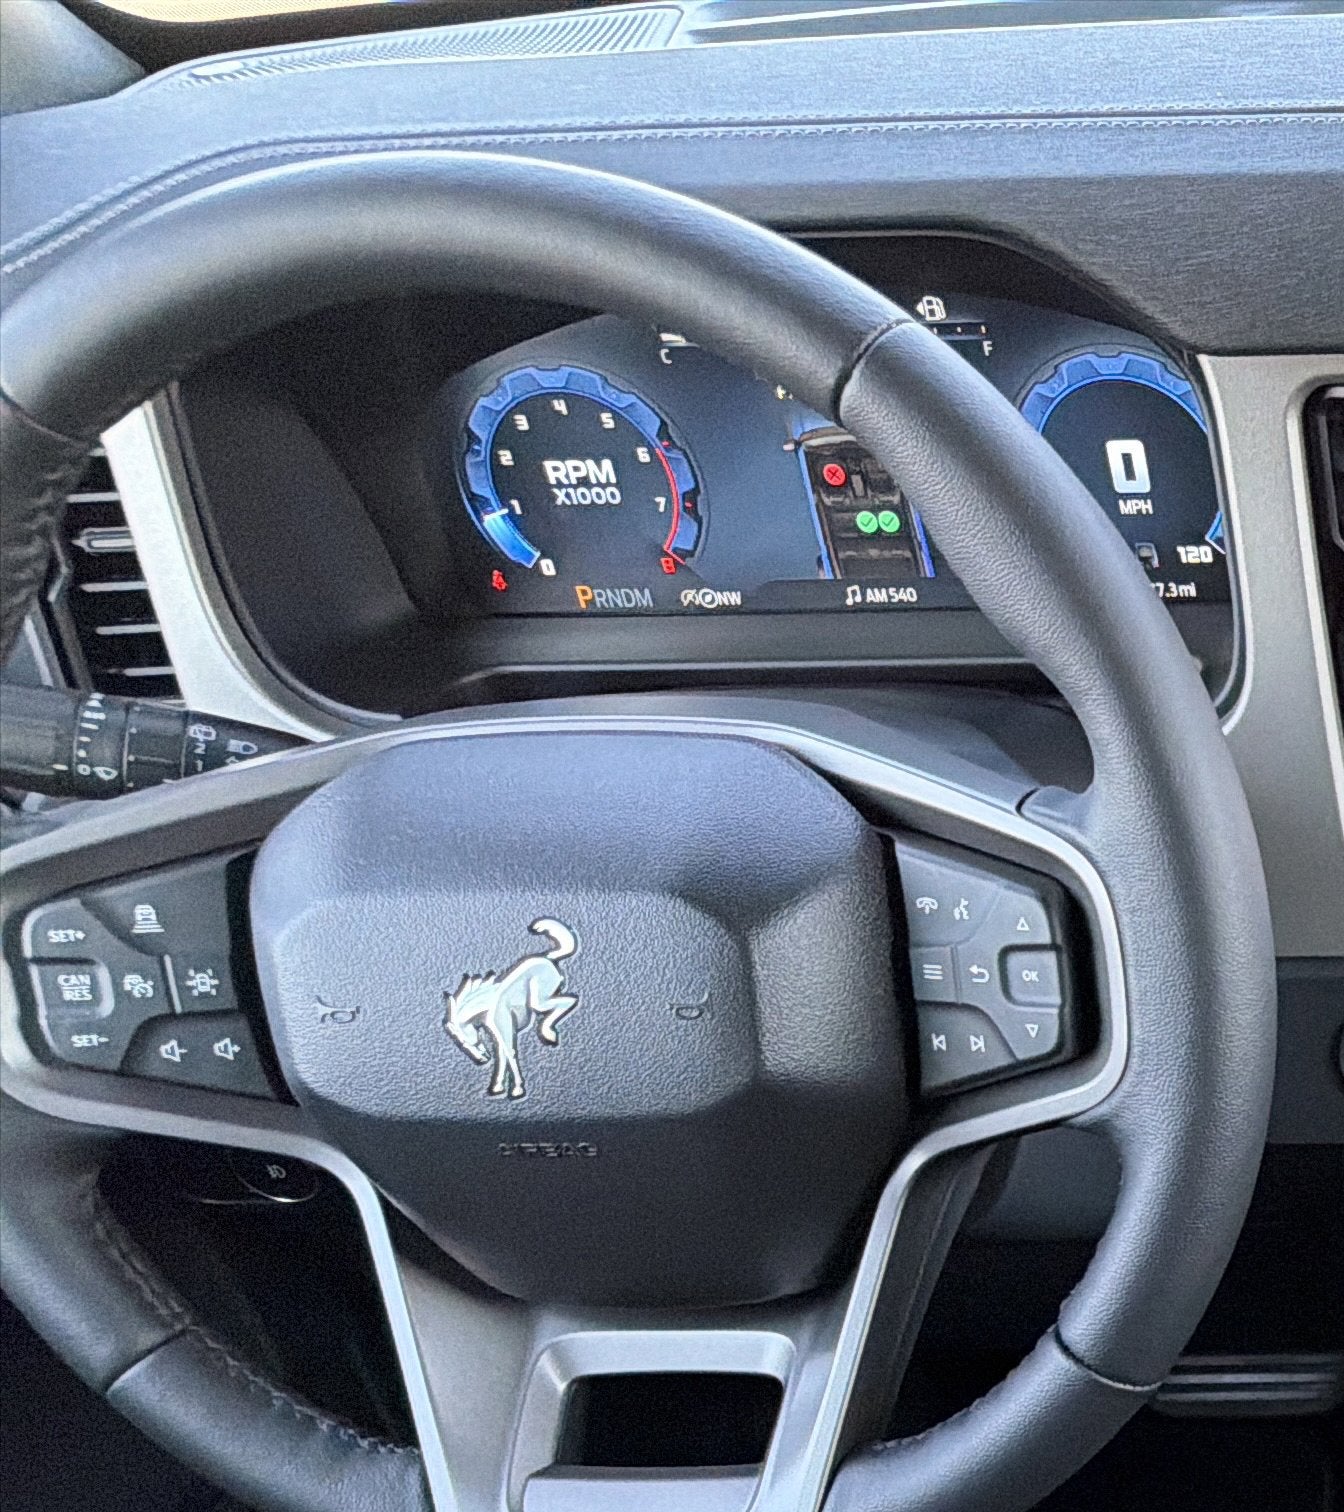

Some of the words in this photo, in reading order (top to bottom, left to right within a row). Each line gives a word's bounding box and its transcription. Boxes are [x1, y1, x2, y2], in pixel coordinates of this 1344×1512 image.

[660, 348, 673, 365] C
[982, 340, 993, 357] F
[552, 399, 569, 416] 4
[513, 414, 530, 431] 3
[600, 412, 616, 429] 5
[497, 449, 515, 466] 2
[636, 446, 651, 463] 6
[542, 458, 617, 485] RPM
[1105, 439, 1151, 494] 0
[552, 486, 622, 506] X1000
[654, 496, 667, 513] 7
[510, 499, 523, 514] 1
[1118, 499, 1154, 515] MPH
[1176, 545, 1214, 564] 120
[539, 558, 557, 576] 0
[718, 591, 742, 606] NW
[865, 588, 888, 603] AM
[890, 587, 918, 602] 540
[1022, 969, 1040, 983] OK
